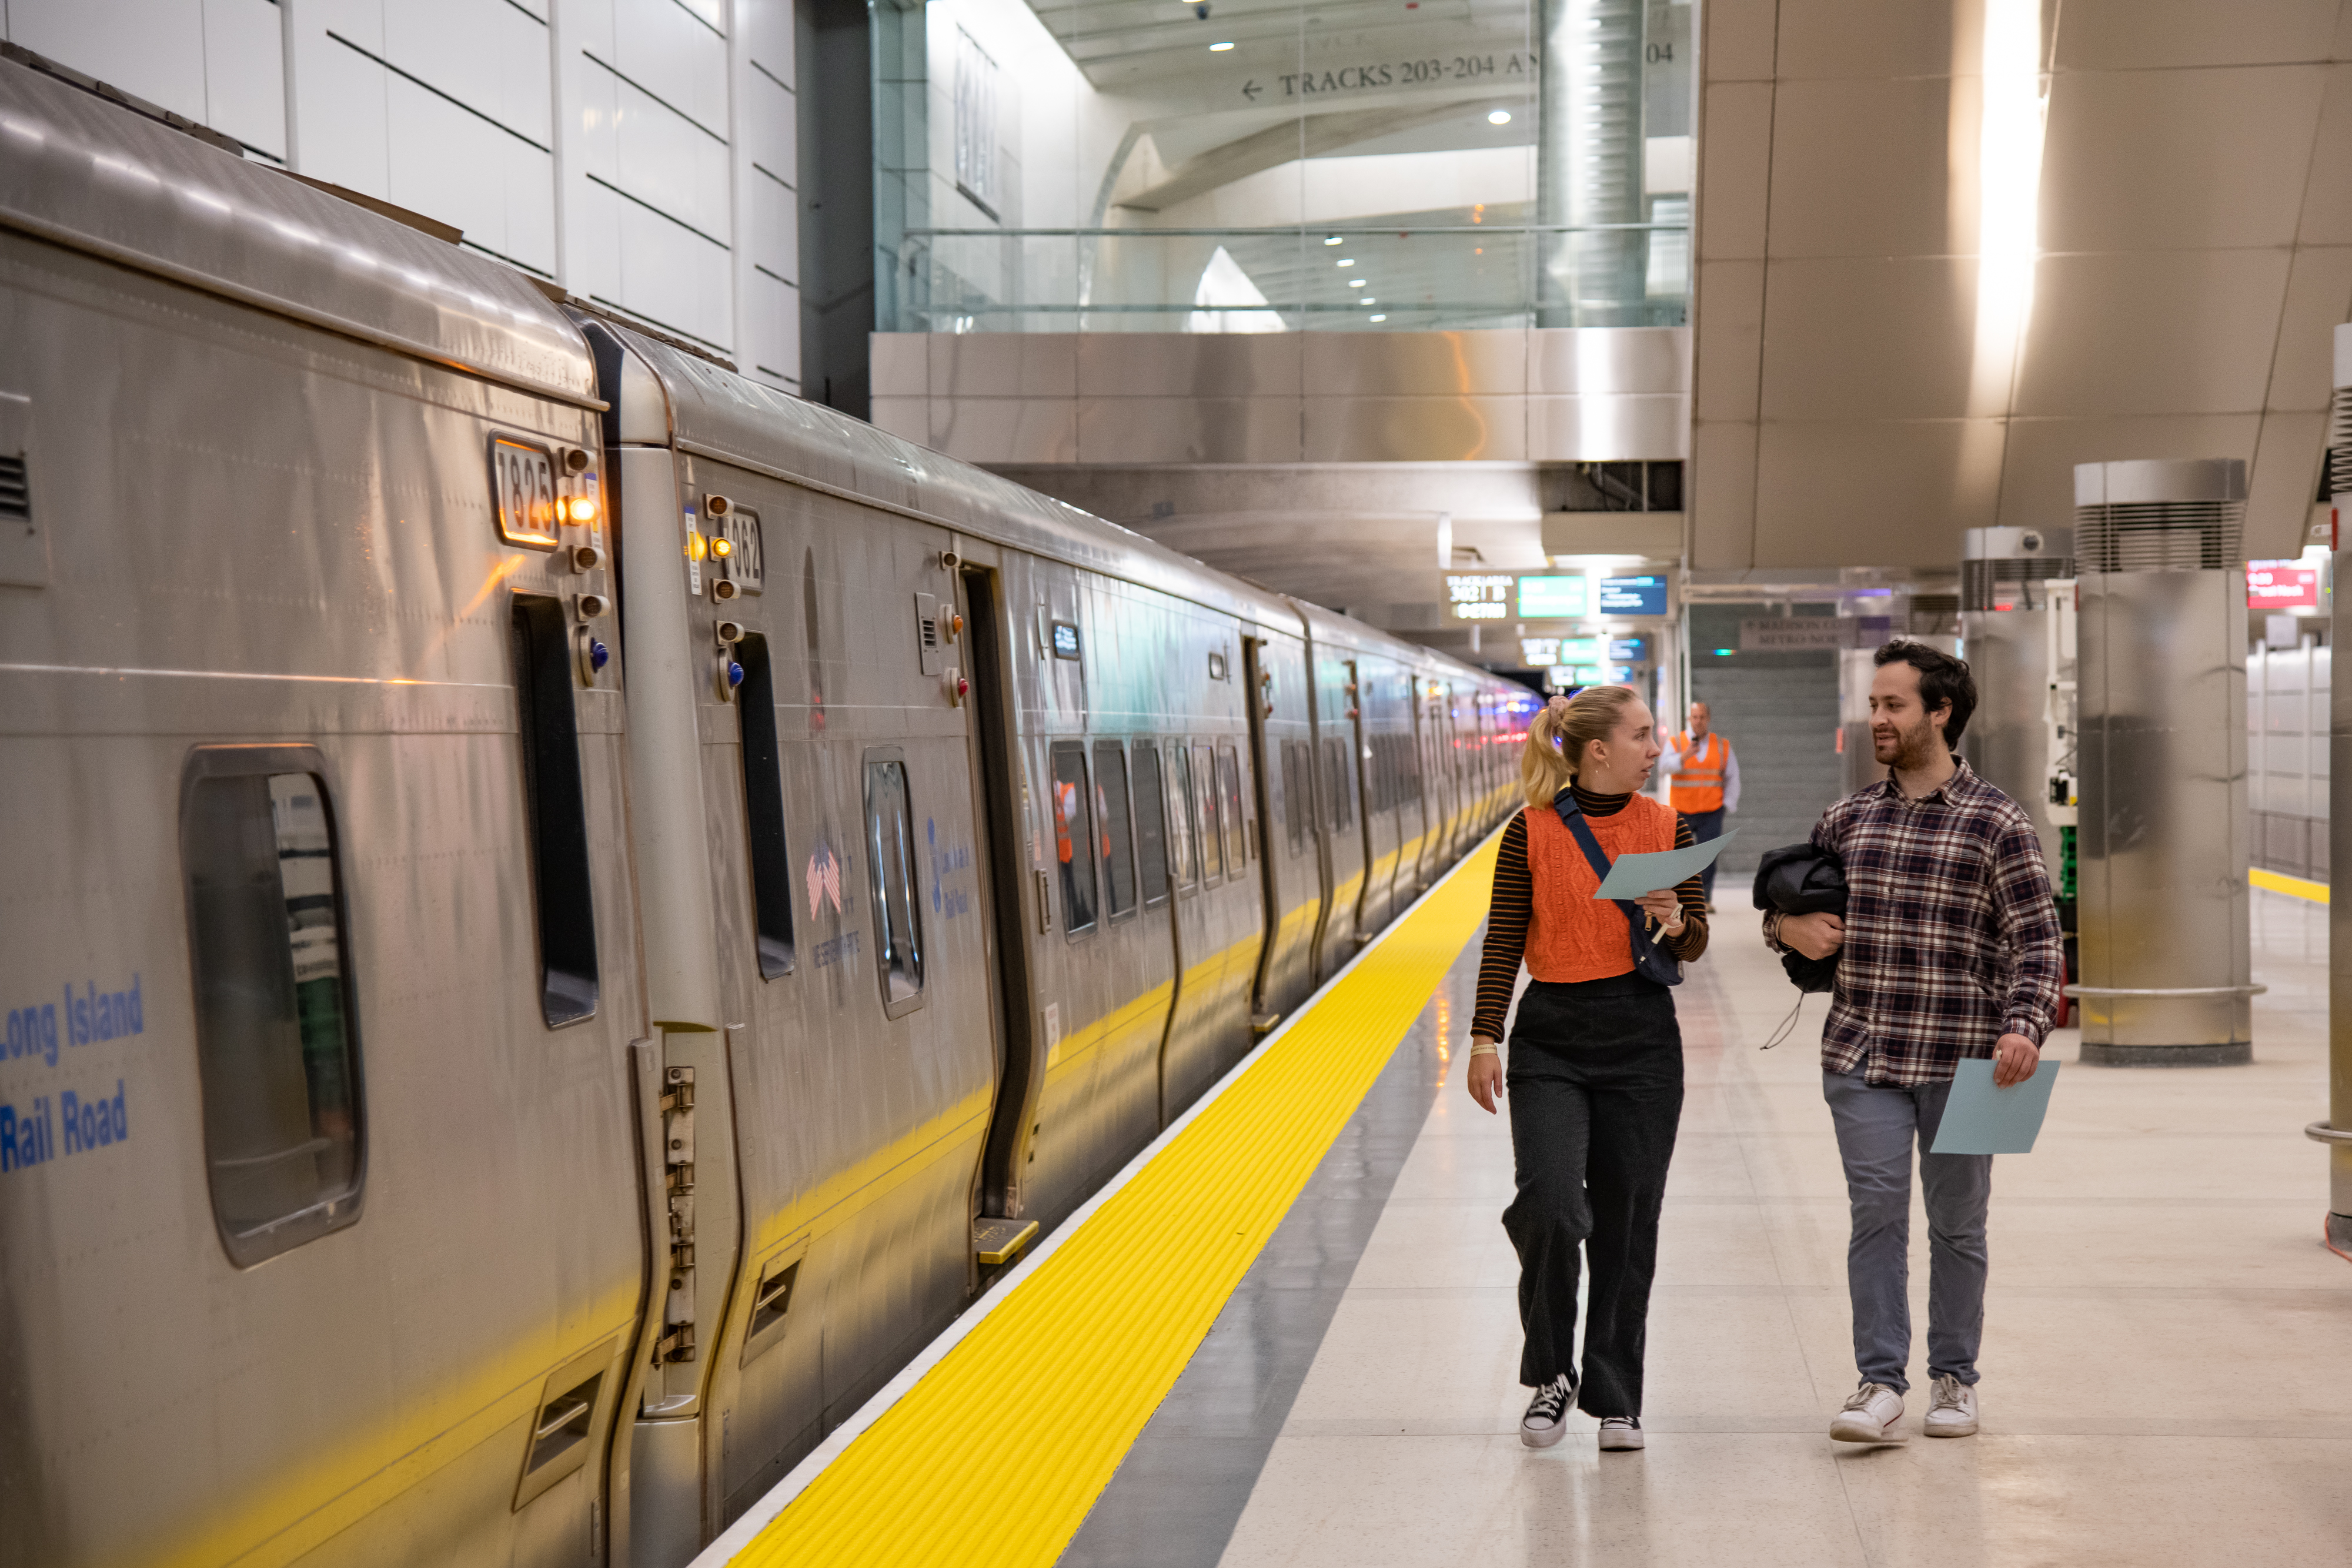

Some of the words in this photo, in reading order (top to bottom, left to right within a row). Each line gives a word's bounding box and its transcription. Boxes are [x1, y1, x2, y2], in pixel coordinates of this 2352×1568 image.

[1279, 63, 1392, 95] TRACKS
[1400, 55, 1495, 83] 203-204
[64, 971, 143, 1047] Island
[0, 1096, 55, 1173] Rail
[61, 1078, 128, 1156] Road
